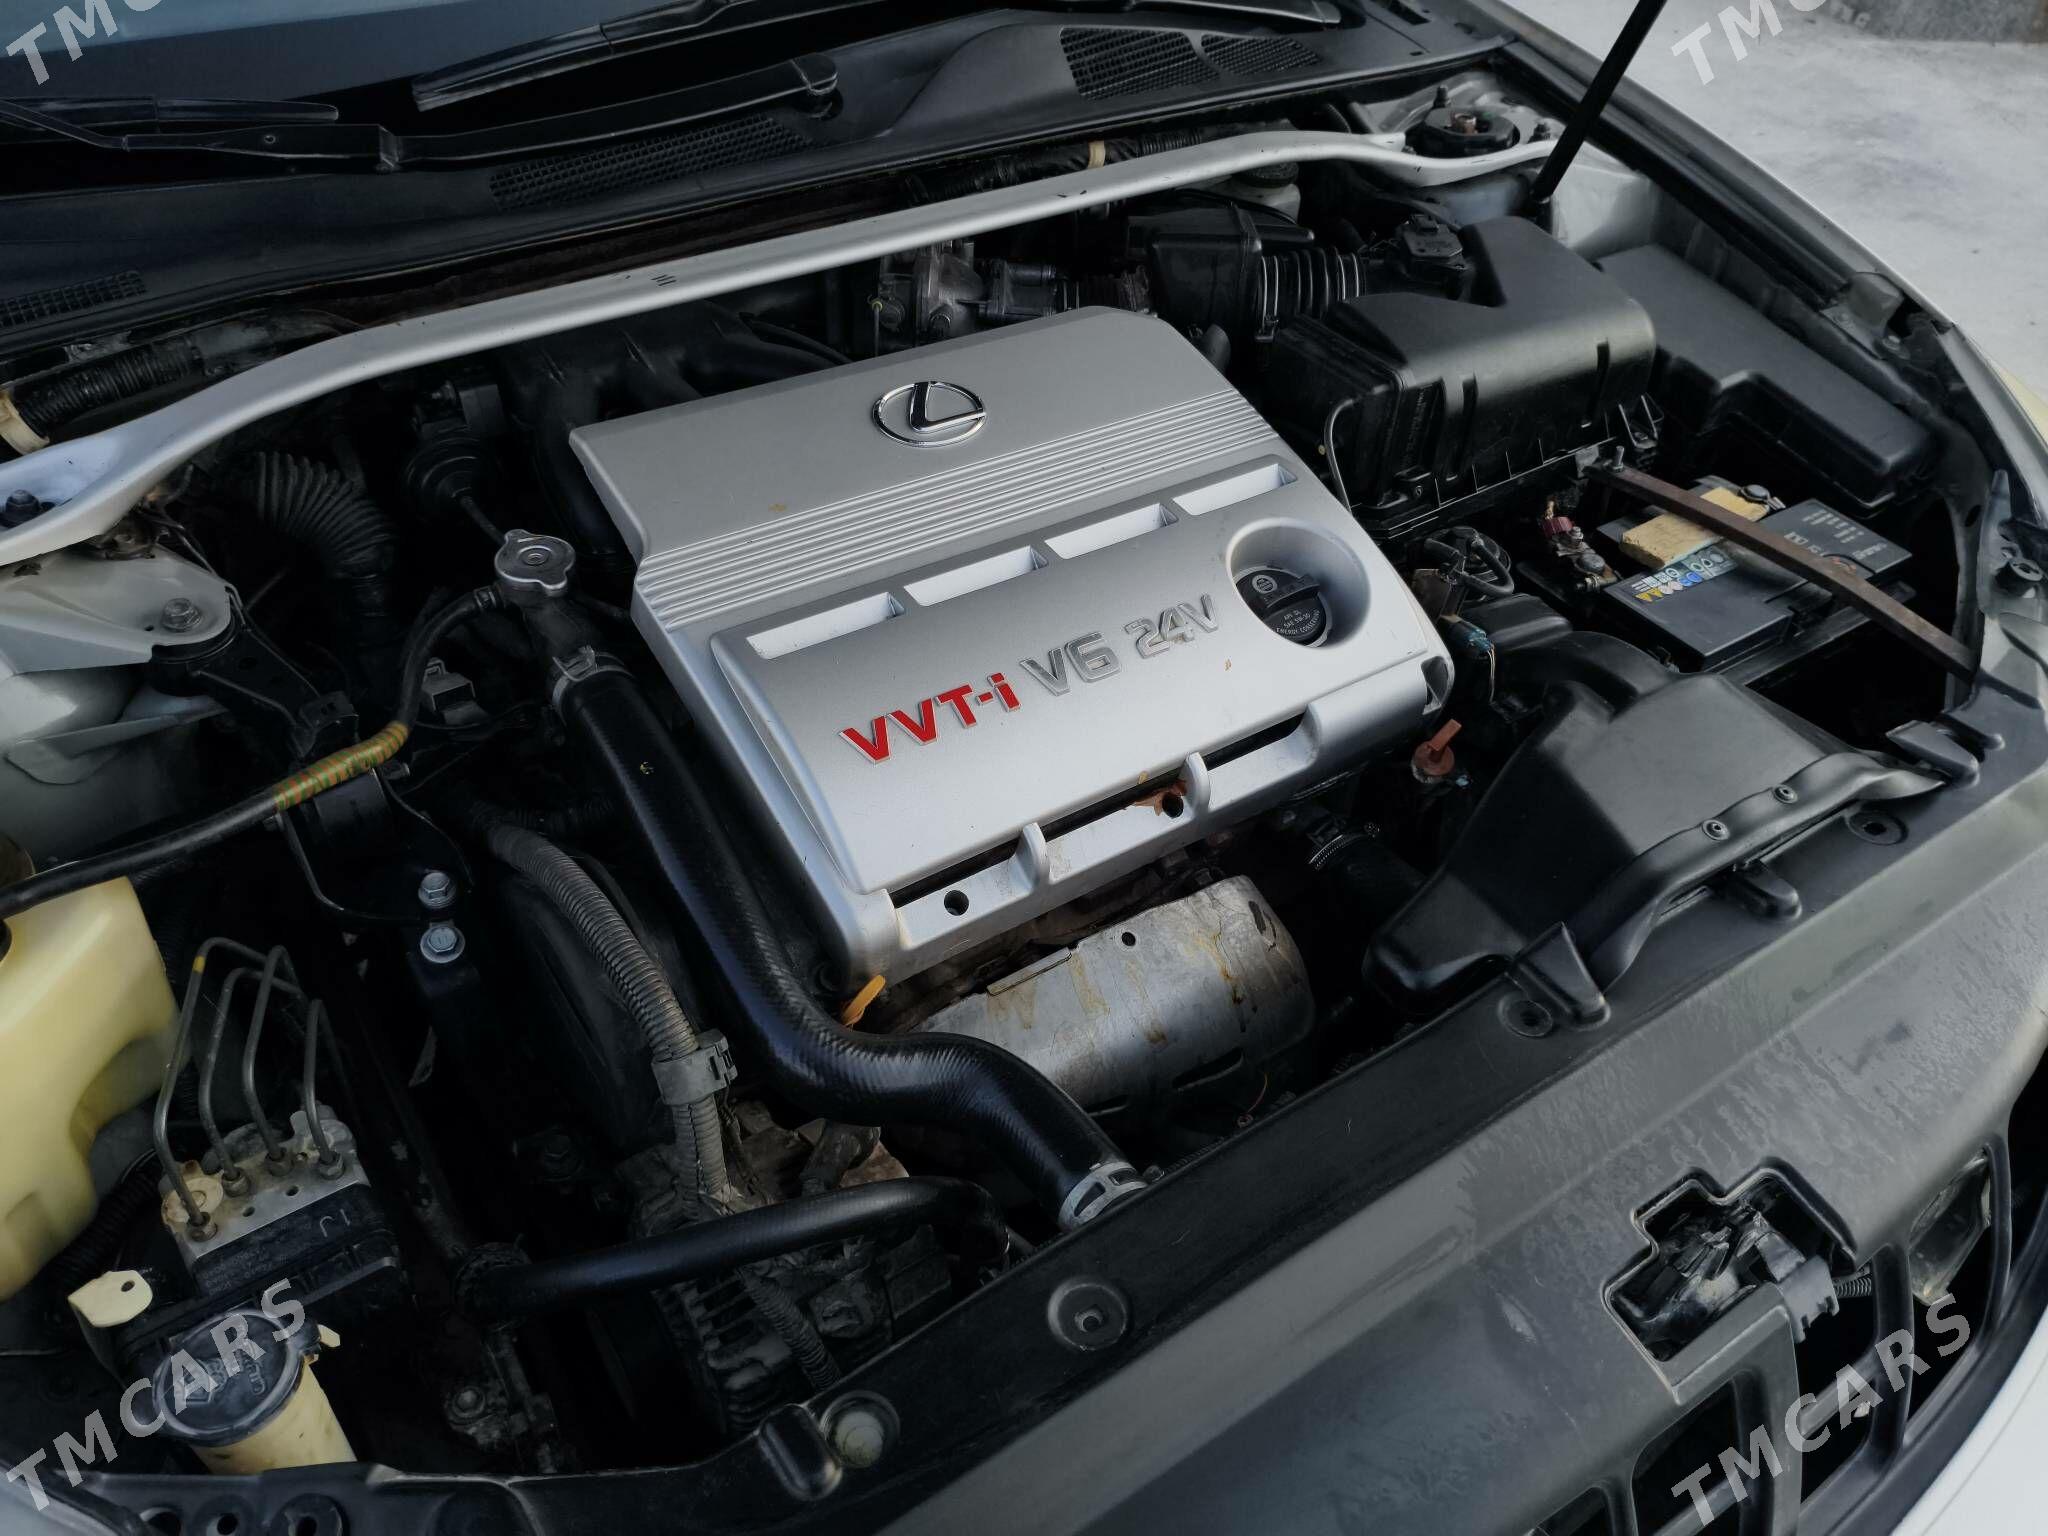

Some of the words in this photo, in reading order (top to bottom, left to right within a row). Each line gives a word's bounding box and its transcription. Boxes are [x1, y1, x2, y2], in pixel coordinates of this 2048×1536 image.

[838, 672, 1022, 765] VVT-i
[1020, 630, 1122, 697] V6
[1125, 593, 1220, 659] 24V
